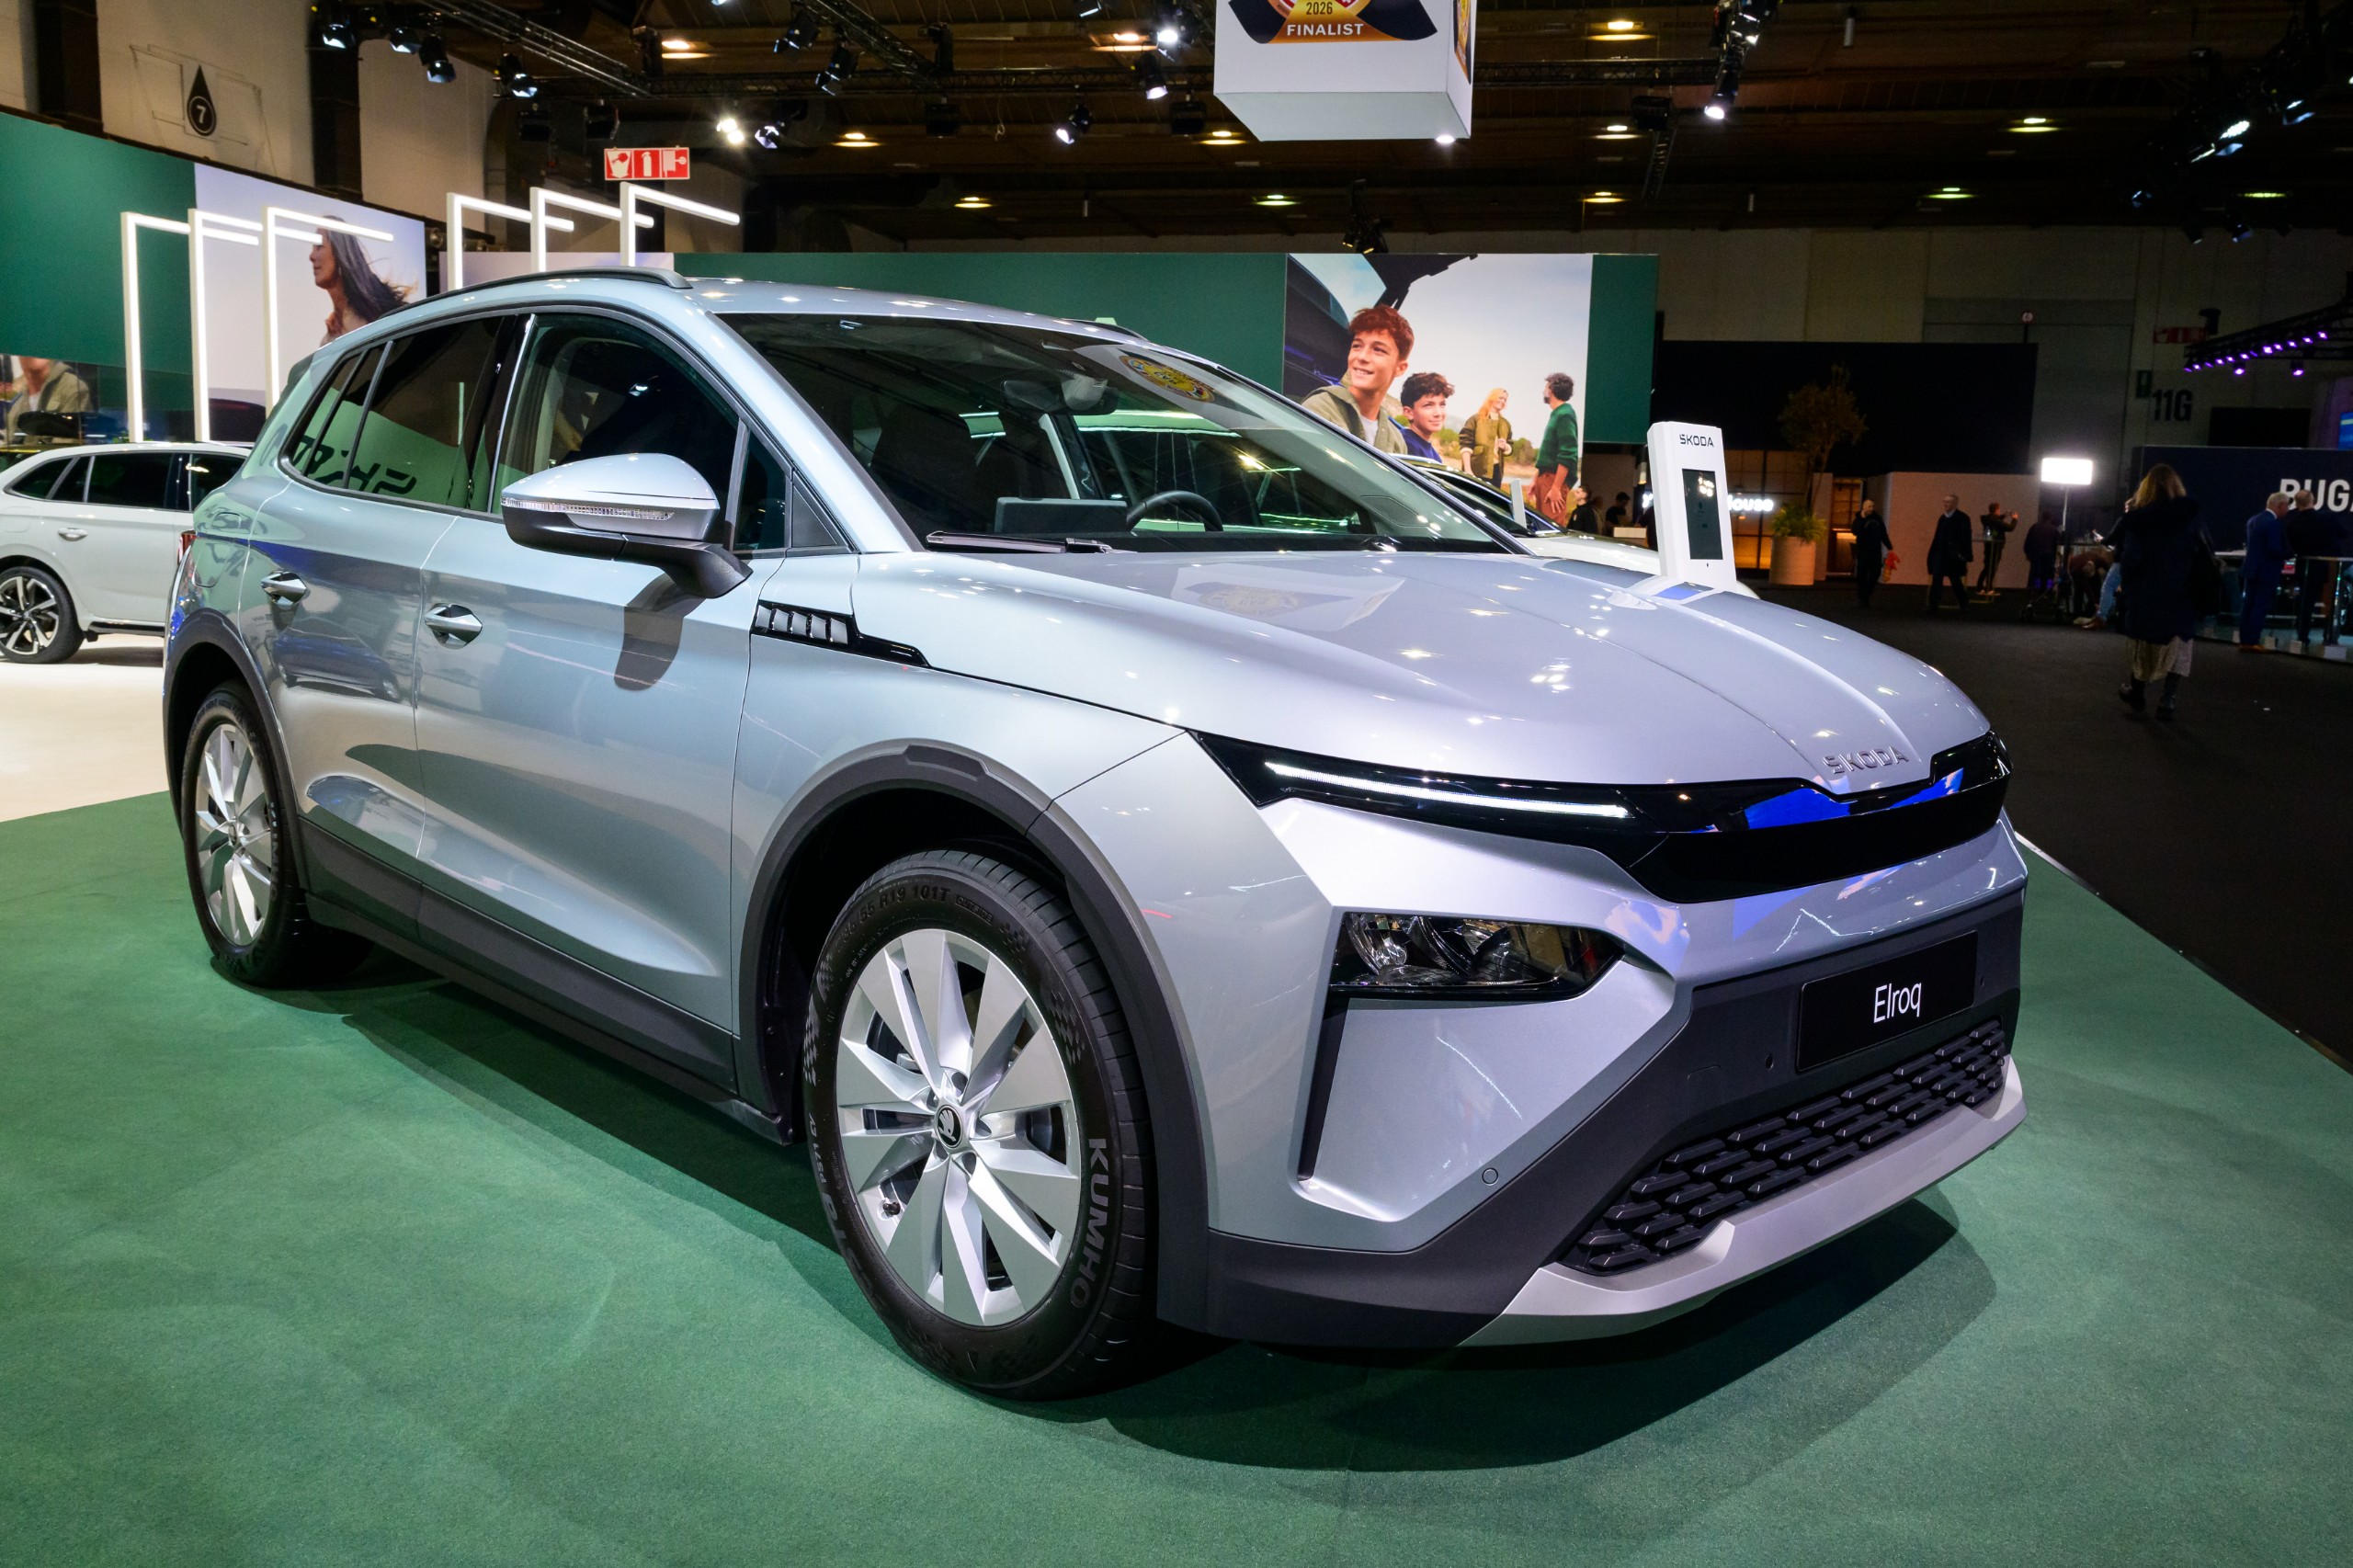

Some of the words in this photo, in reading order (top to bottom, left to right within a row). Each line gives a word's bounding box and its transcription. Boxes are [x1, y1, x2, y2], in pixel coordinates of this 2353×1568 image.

[1306, 1, 1333, 16] 2026
[1286, 23, 1364, 37] FINALIST
[196, 104, 207, 124] 7
[2152, 388, 2194, 422] 11G
[2279, 478, 2353, 513] BUG
[913, 884, 950, 903] 101T
[1873, 982, 1922, 1024] Elroq
[1070, 1138, 1109, 1309] KUMHO
